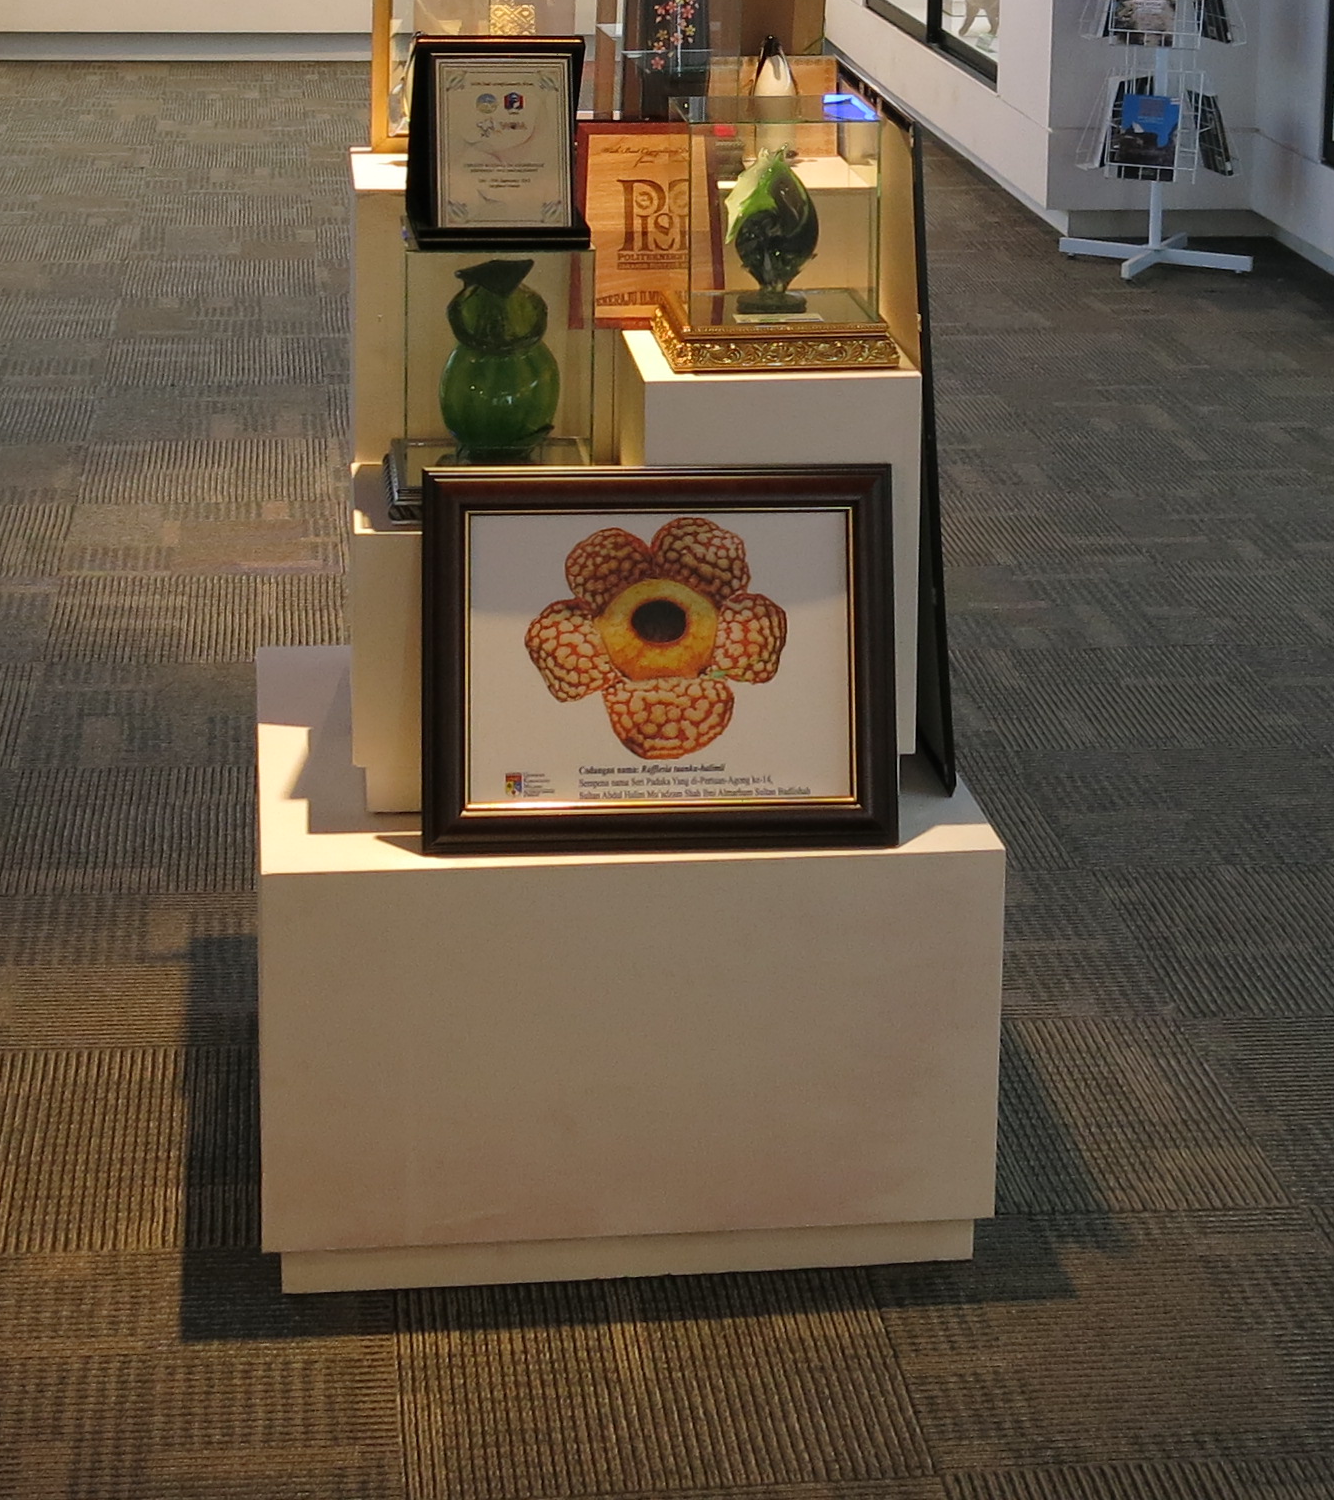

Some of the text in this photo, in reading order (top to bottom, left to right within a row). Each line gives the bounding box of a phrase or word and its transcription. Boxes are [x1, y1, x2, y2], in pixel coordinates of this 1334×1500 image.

[578, 766, 615, 776] Cadangan
[641, 764, 672, 775] Rafflesia
[578, 778, 609, 788] Sempena
[646, 777, 670, 786] Paduka
[672, 777, 689, 787] Yang
[579, 791, 601, 799] Sultan
[602, 790, 623, 799] Abdul
[684, 789, 701, 797] Shah
